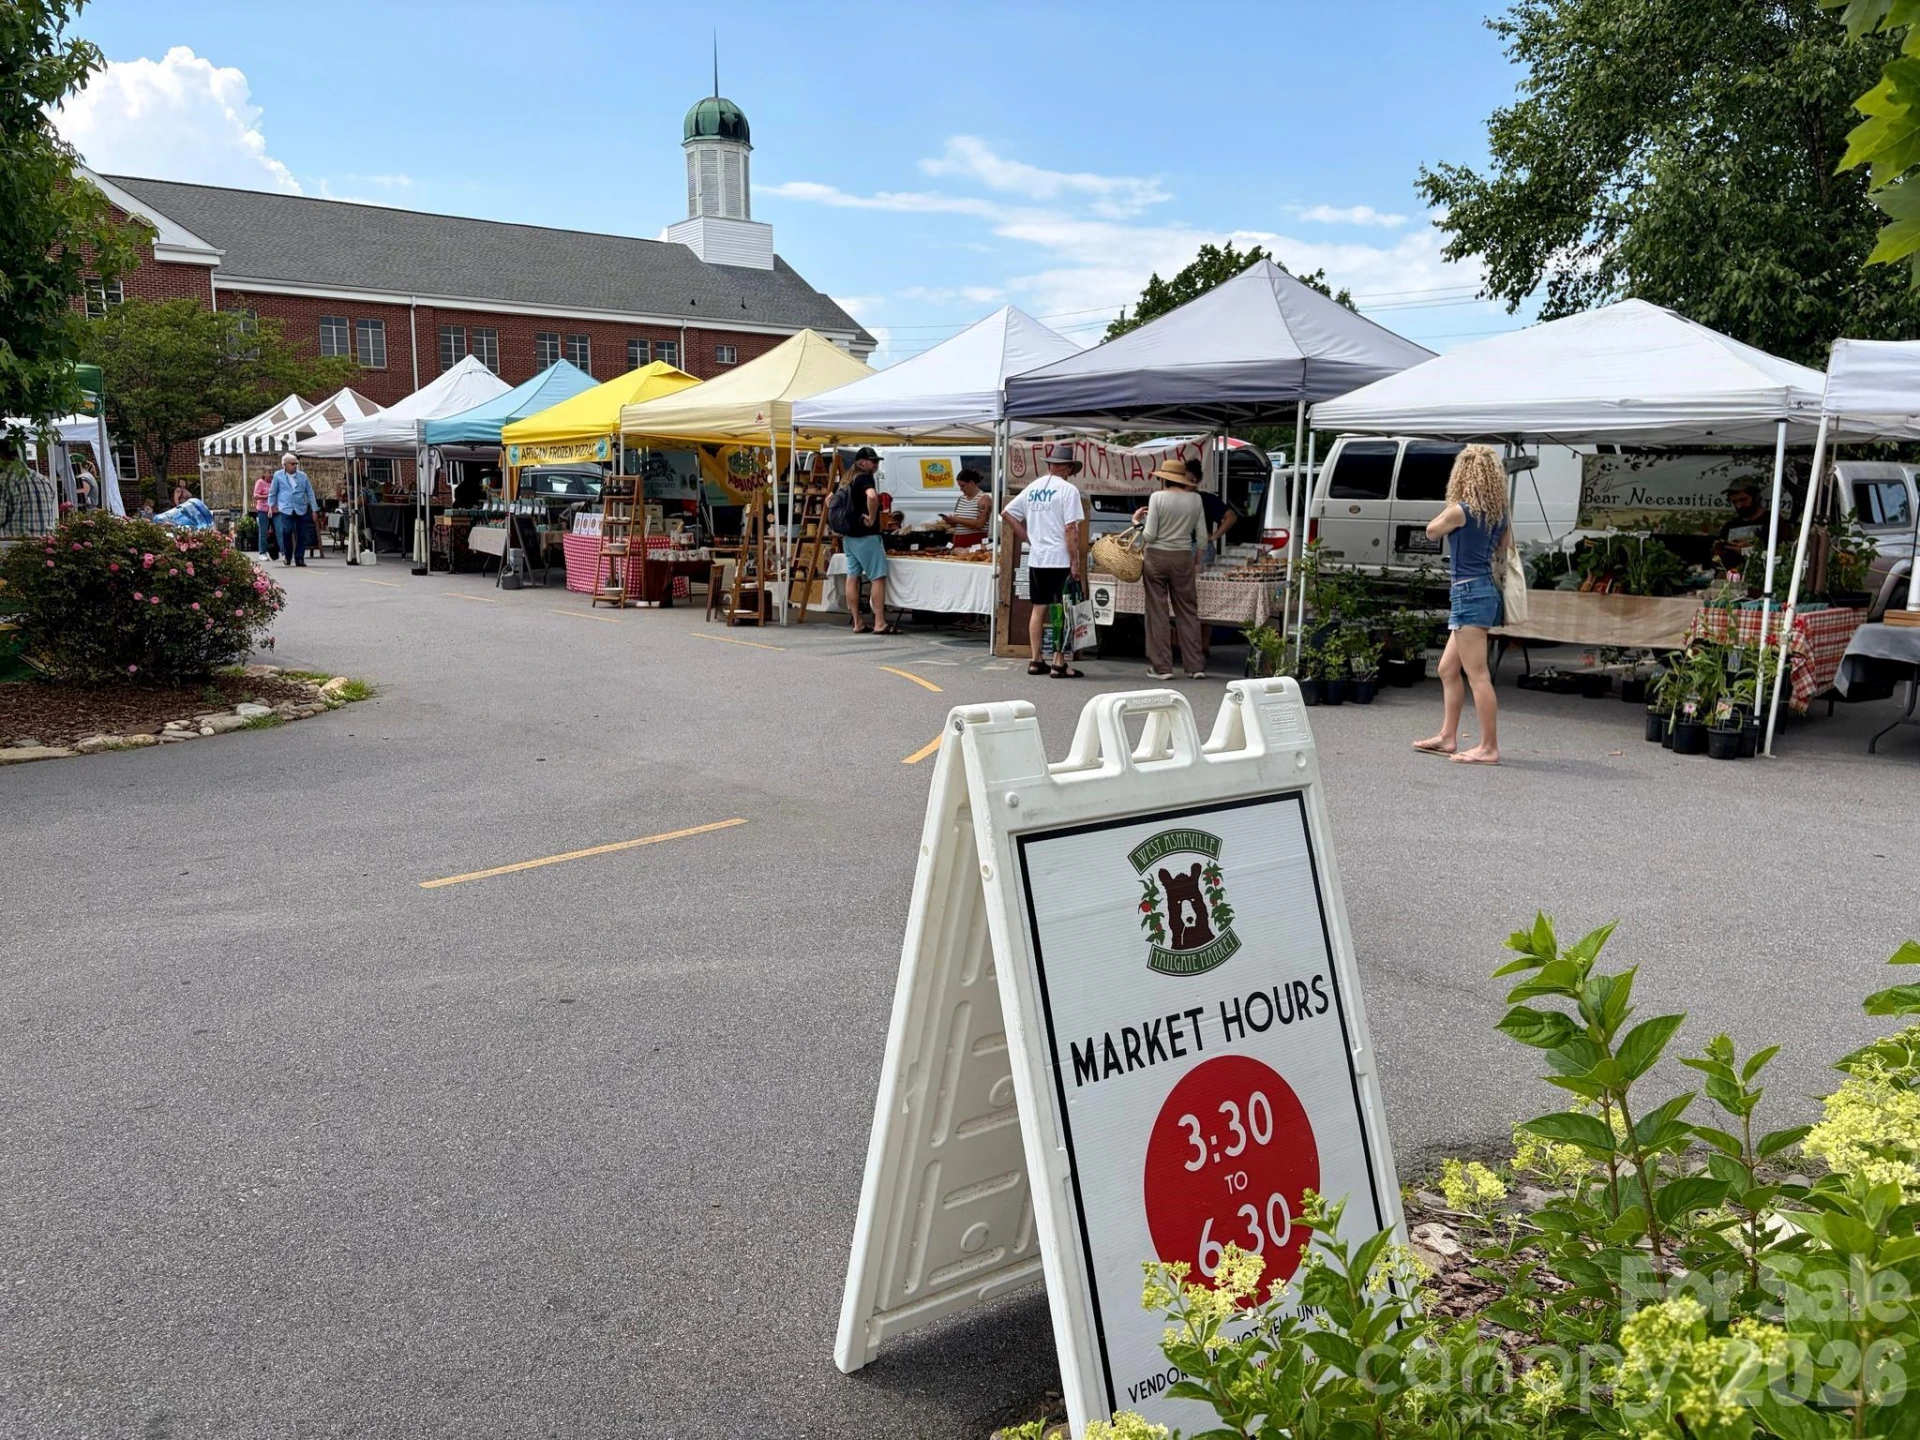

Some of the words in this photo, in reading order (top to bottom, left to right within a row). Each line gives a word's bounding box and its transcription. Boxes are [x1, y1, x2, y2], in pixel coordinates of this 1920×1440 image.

[521, 446, 548, 460] ARTISAN
[549, 444, 574, 459] FROZEN
[1032, 441, 1110, 480] FRNCH
[1028, 488, 1057, 502] SKYY
[1583, 486, 1620, 505] Bear
[1625, 486, 1732, 508] Necessities
[1135, 839, 1164, 865] WEST
[1163, 832, 1215, 853] ASHEVILLE
[1154, 950, 1199, 971] TAILGATE
[1200, 934, 1236, 968] MARKET
[1070, 1006, 1204, 1087] MARKET
[1219, 974, 1329, 1043] HOURS
[1177, 1090, 1274, 1171] 3:30
[1224, 1170, 1248, 1195] TO
[1198, 1192, 1291, 1278] 630
